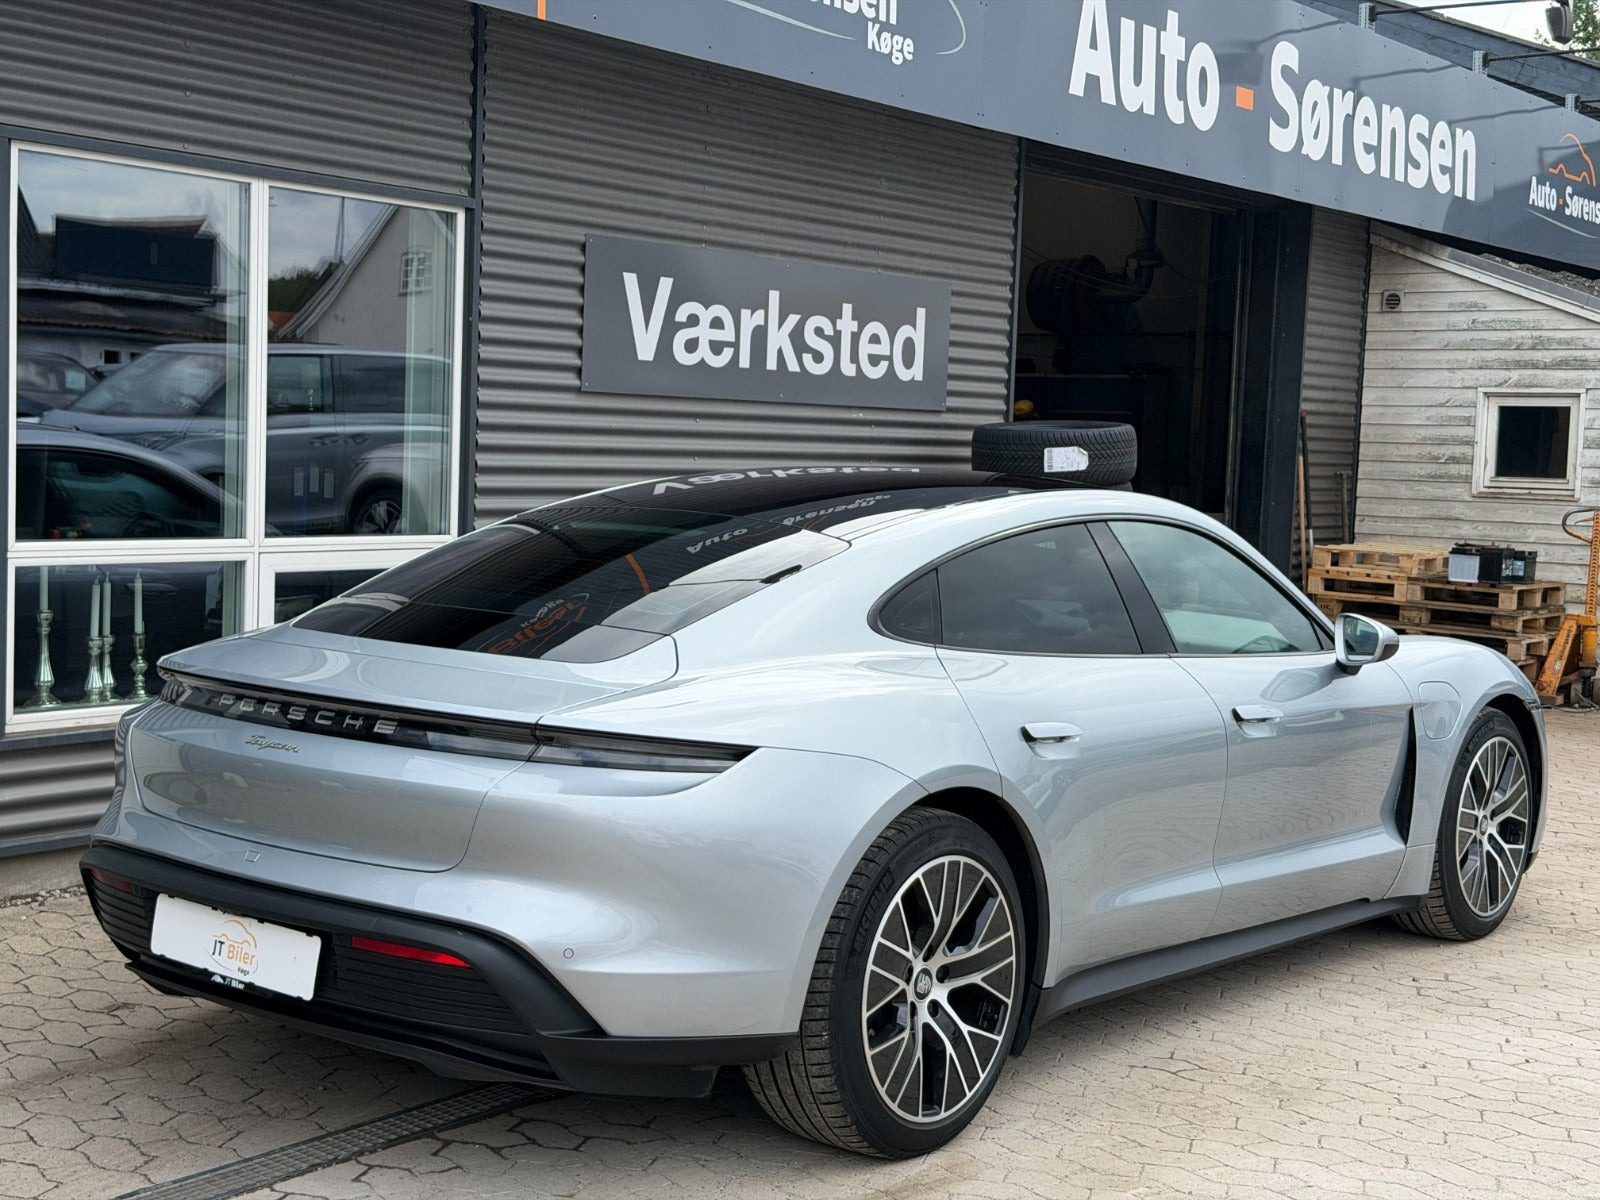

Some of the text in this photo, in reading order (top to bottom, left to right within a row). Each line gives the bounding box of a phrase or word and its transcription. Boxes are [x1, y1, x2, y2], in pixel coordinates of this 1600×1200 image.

[867, 21, 914, 65] Køge
[1068, 0, 1221, 132] Auto
[1268, 40, 1477, 202] Sørensen
[1528, 175, 1558, 212] Auto
[622, 271, 927, 382] Værksted
[218, 694, 398, 735] PORSCHE
[245, 734, 300, 754] Taycan
[212, 939, 255, 966] JT Biler
